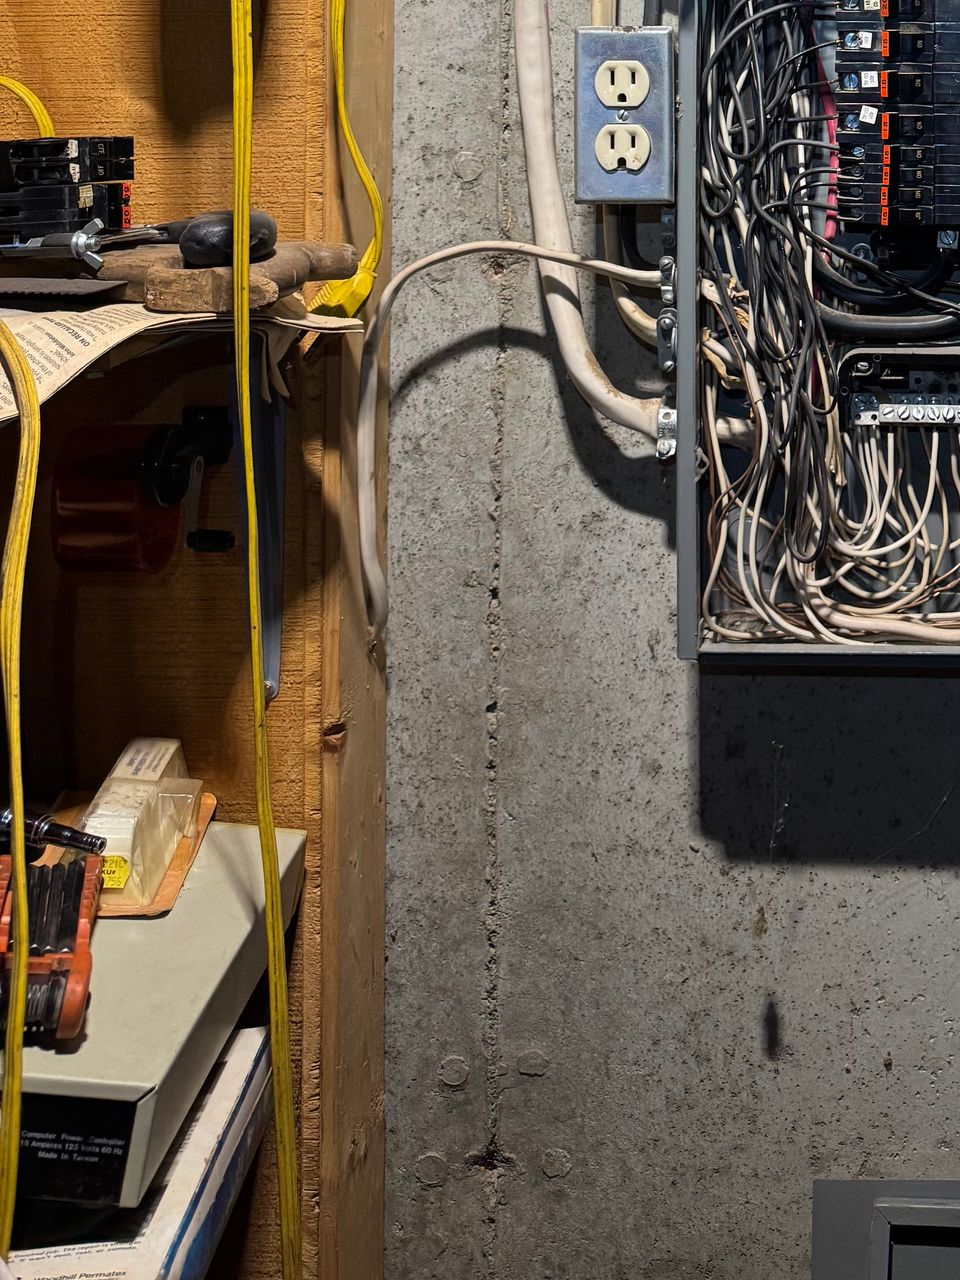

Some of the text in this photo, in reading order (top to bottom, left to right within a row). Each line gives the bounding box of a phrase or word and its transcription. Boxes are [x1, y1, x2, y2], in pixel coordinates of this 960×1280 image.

[78, 338, 90, 347] ON
[21, 1130, 125, 1146] Computer Power Controller
[30, 1140, 62, 1150] Amperes
[38, 1151, 58, 1159] Made
[73, 1153, 99, 1162] Taiwan
[79, 1269, 127, 1278] Permatex
